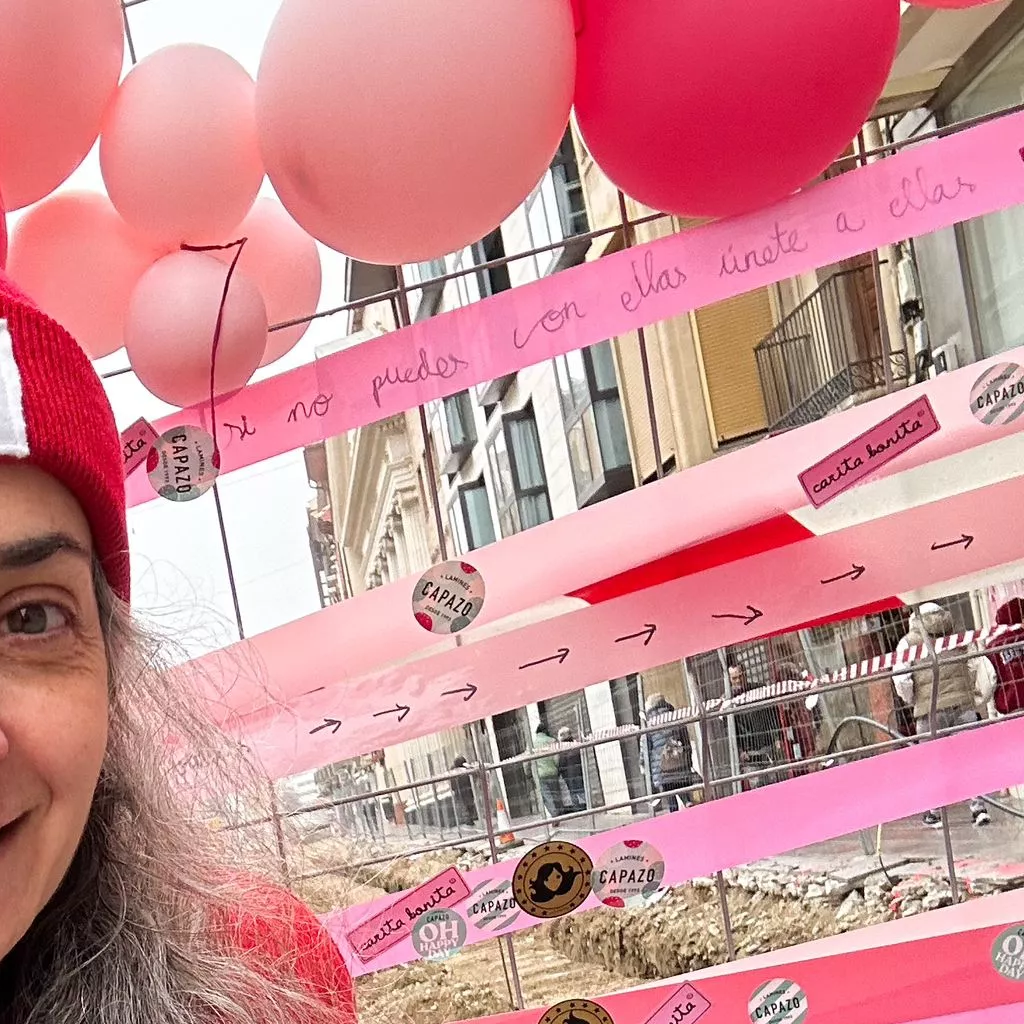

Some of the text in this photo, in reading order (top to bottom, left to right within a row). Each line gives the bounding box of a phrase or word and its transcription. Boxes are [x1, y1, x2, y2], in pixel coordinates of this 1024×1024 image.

[287, 392, 334, 424] no
[371, 350, 469, 407] puedes
[513, 299, 587, 350] con
[620, 250, 688, 312] ellas
[719, 221, 809, 278] únete
[836, 211, 865, 233] a
[889, 166, 977, 217] ellas
[977, 382, 1024, 409] CAPAZO
[172, 434, 191, 493] CAPAZO
[813, 419, 923, 494] carita bonita
[421, 581, 473, 617] CAPAZO
[599, 868, 655, 884] CAPAZO
[358, 886, 456, 951] carita bonita
[472, 898, 516, 915] CAPAZO
[418, 920, 459, 943] OH
[419, 938, 459, 953] HAPPY
[755, 996, 800, 1019] CAPAZO
